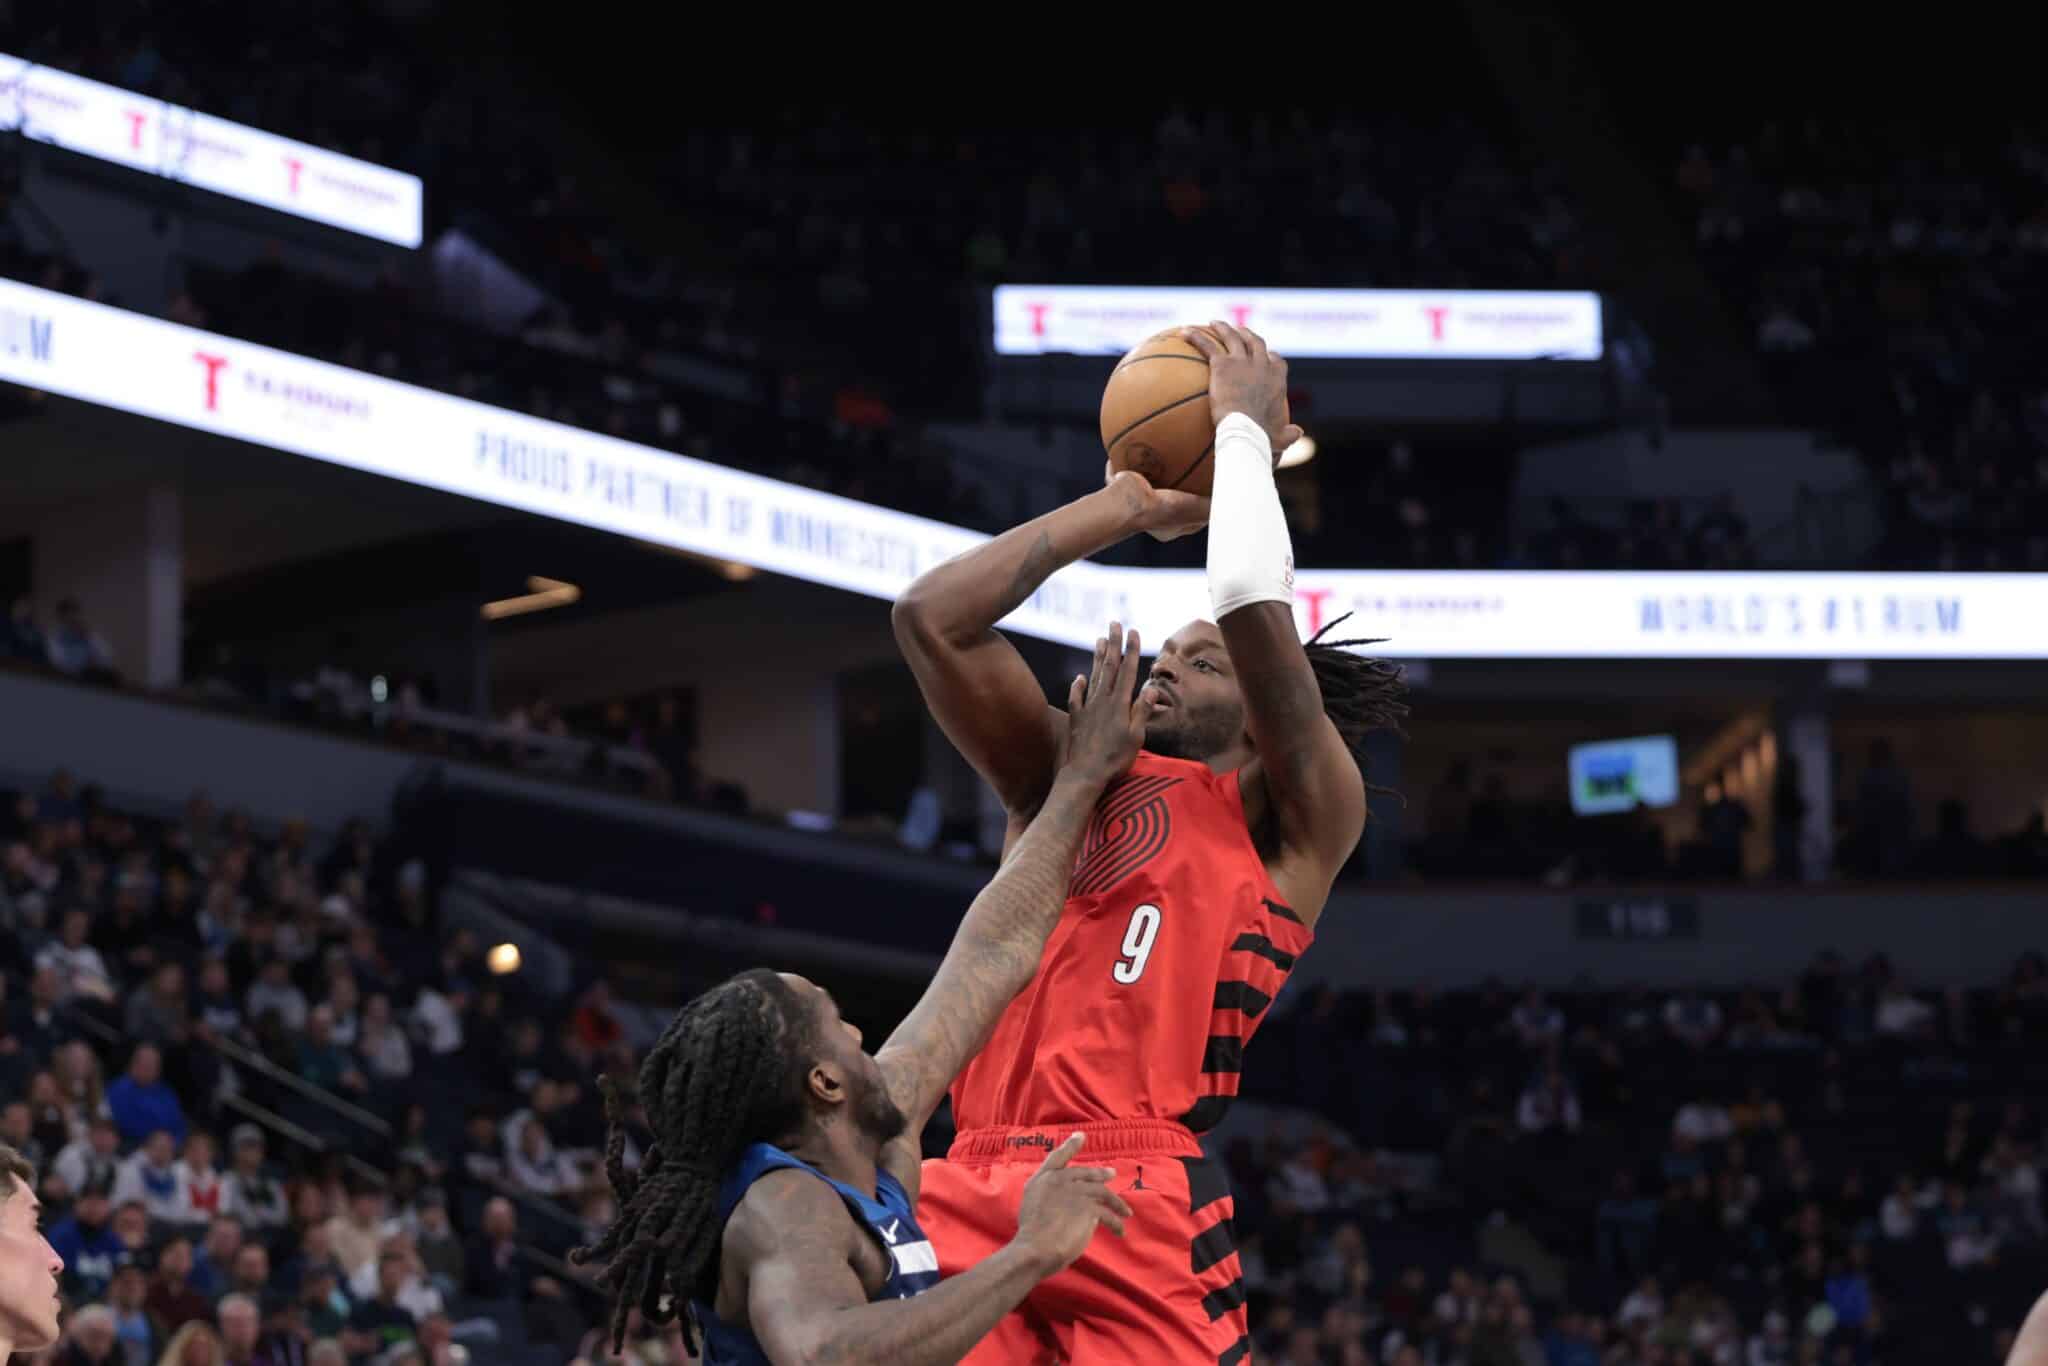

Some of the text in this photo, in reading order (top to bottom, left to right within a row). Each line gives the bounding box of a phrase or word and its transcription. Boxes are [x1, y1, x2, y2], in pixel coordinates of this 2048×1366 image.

[193, 350, 229, 412] T
[474, 429, 571, 495] PROUD
[769, 507, 919, 577] MINNESOTA
[1112, 904, 1162, 984] 9
